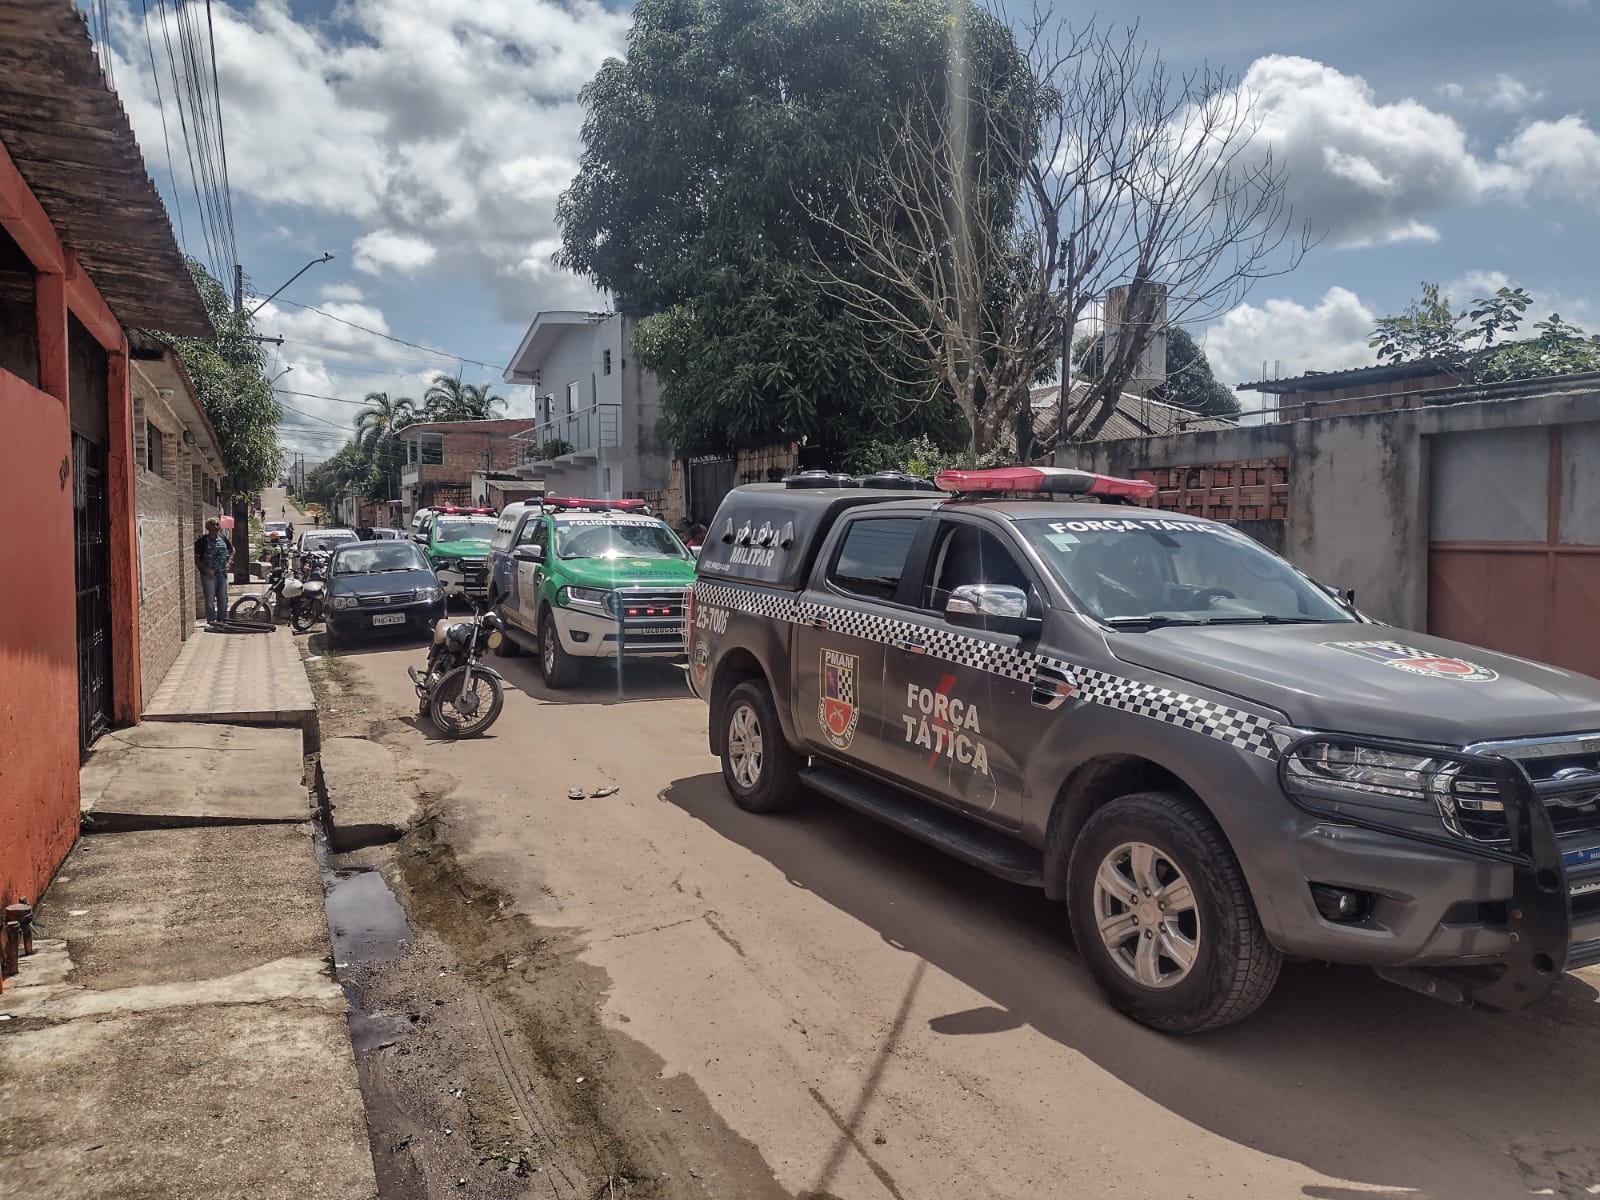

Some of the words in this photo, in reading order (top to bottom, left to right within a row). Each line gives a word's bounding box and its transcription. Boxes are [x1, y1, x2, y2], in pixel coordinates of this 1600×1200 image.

[568, 519, 613, 527] POLÍCIA
[616, 520, 661, 528] MILITAR
[1048, 519, 1146, 534] FORÇA
[729, 546, 775, 567] MILITAR
[825, 651, 854, 669] PMAM
[907, 682, 981, 734] FORÇA
[902, 714, 988, 776] TÁTICA
